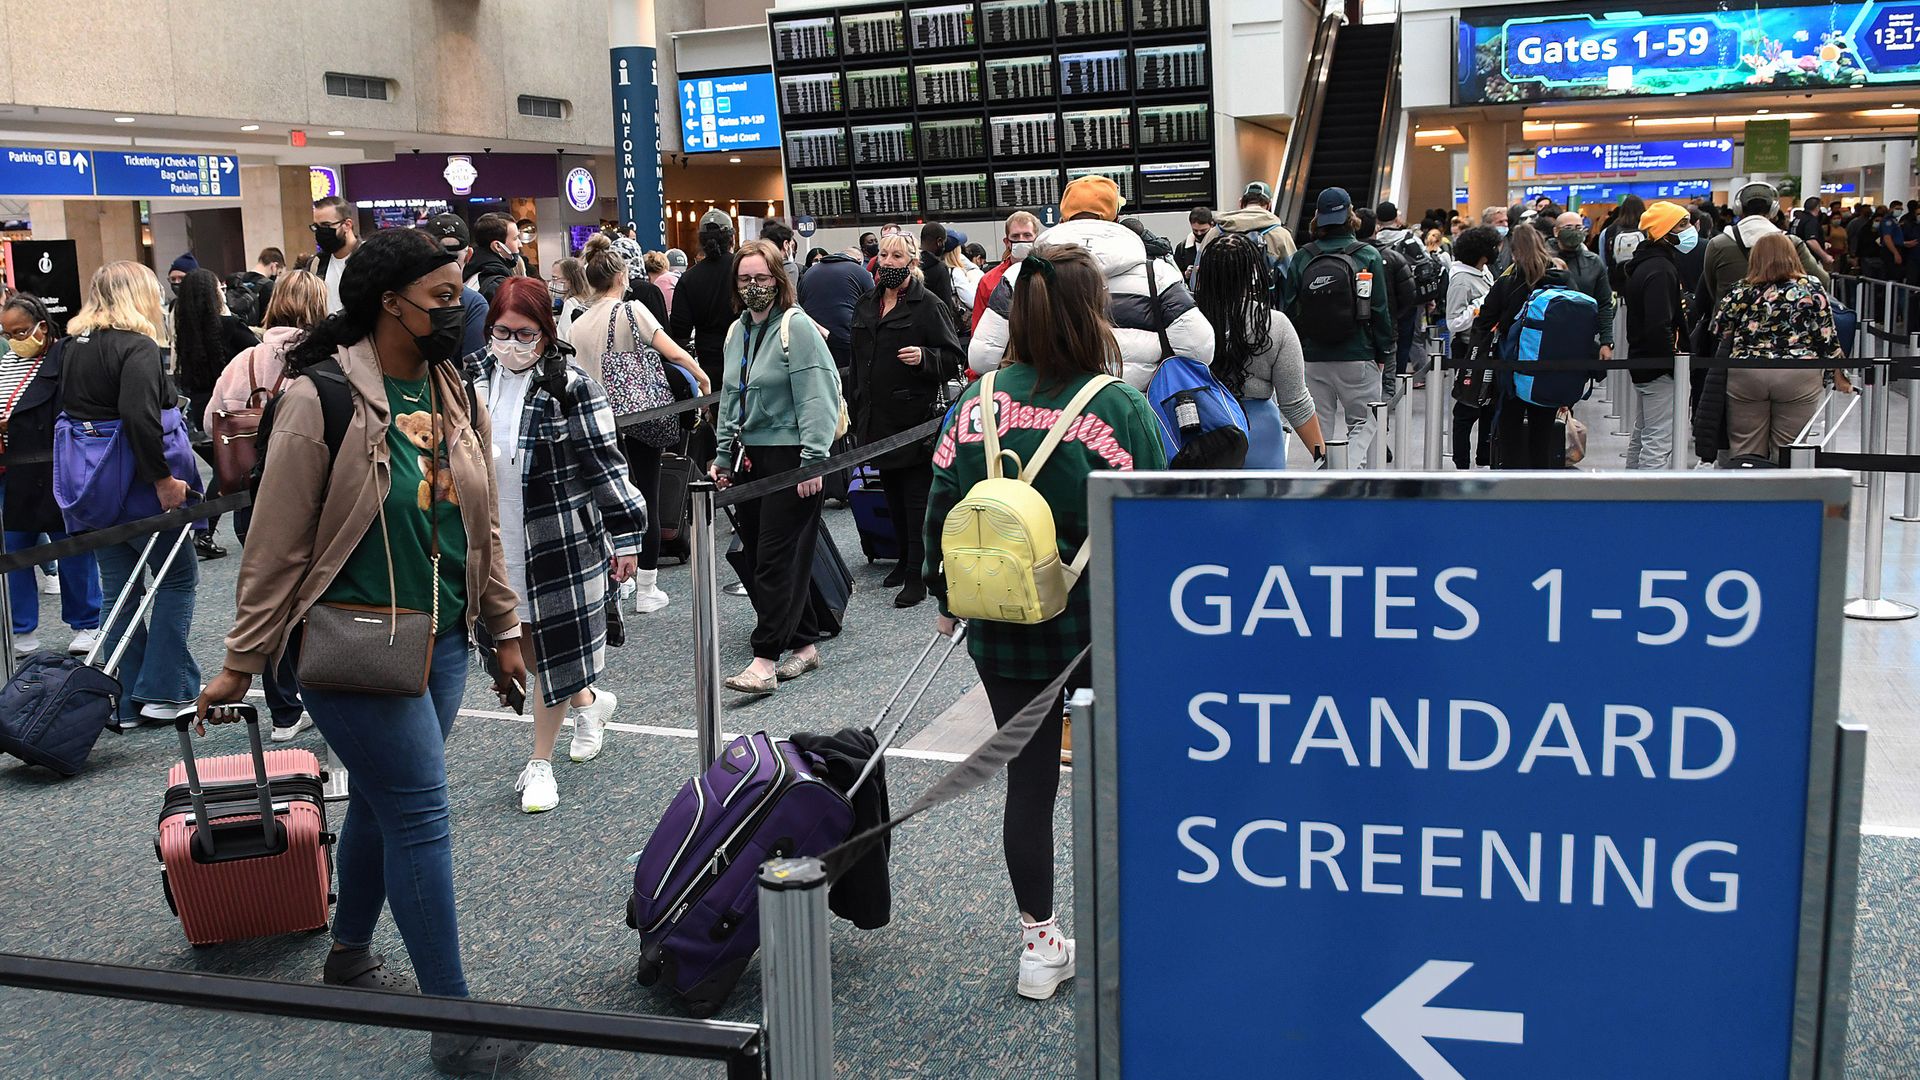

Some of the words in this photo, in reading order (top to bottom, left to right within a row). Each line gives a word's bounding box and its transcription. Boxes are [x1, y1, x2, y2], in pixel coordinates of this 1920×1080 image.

[1517, 36, 1618, 65] Gates
[1632, 26, 1709, 59] 1-59
[715, 81, 747, 93] Terminal
[718, 117, 740, 126] Gates
[740, 114, 765, 125] 70-129
[719, 133, 738, 143] Food
[739, 132, 760, 142] Court
[8, 151, 44, 166] Parking
[124, 155, 160, 169] Ticketing
[622, 98, 636, 231] INFORMATIO
[161, 169, 176, 182] Bag
[176, 170, 198, 180] Claim
[654, 98, 666, 246] INFORMATION
[170, 183, 199, 196] Parking
[1314, 276, 1334, 284] NIKE
[1169, 564, 1481, 640] GATES
[1532, 569, 1762, 647] 1-59
[1187, 692, 1737, 781] STANDARD
[1177, 816, 1740, 912] SCREENING
